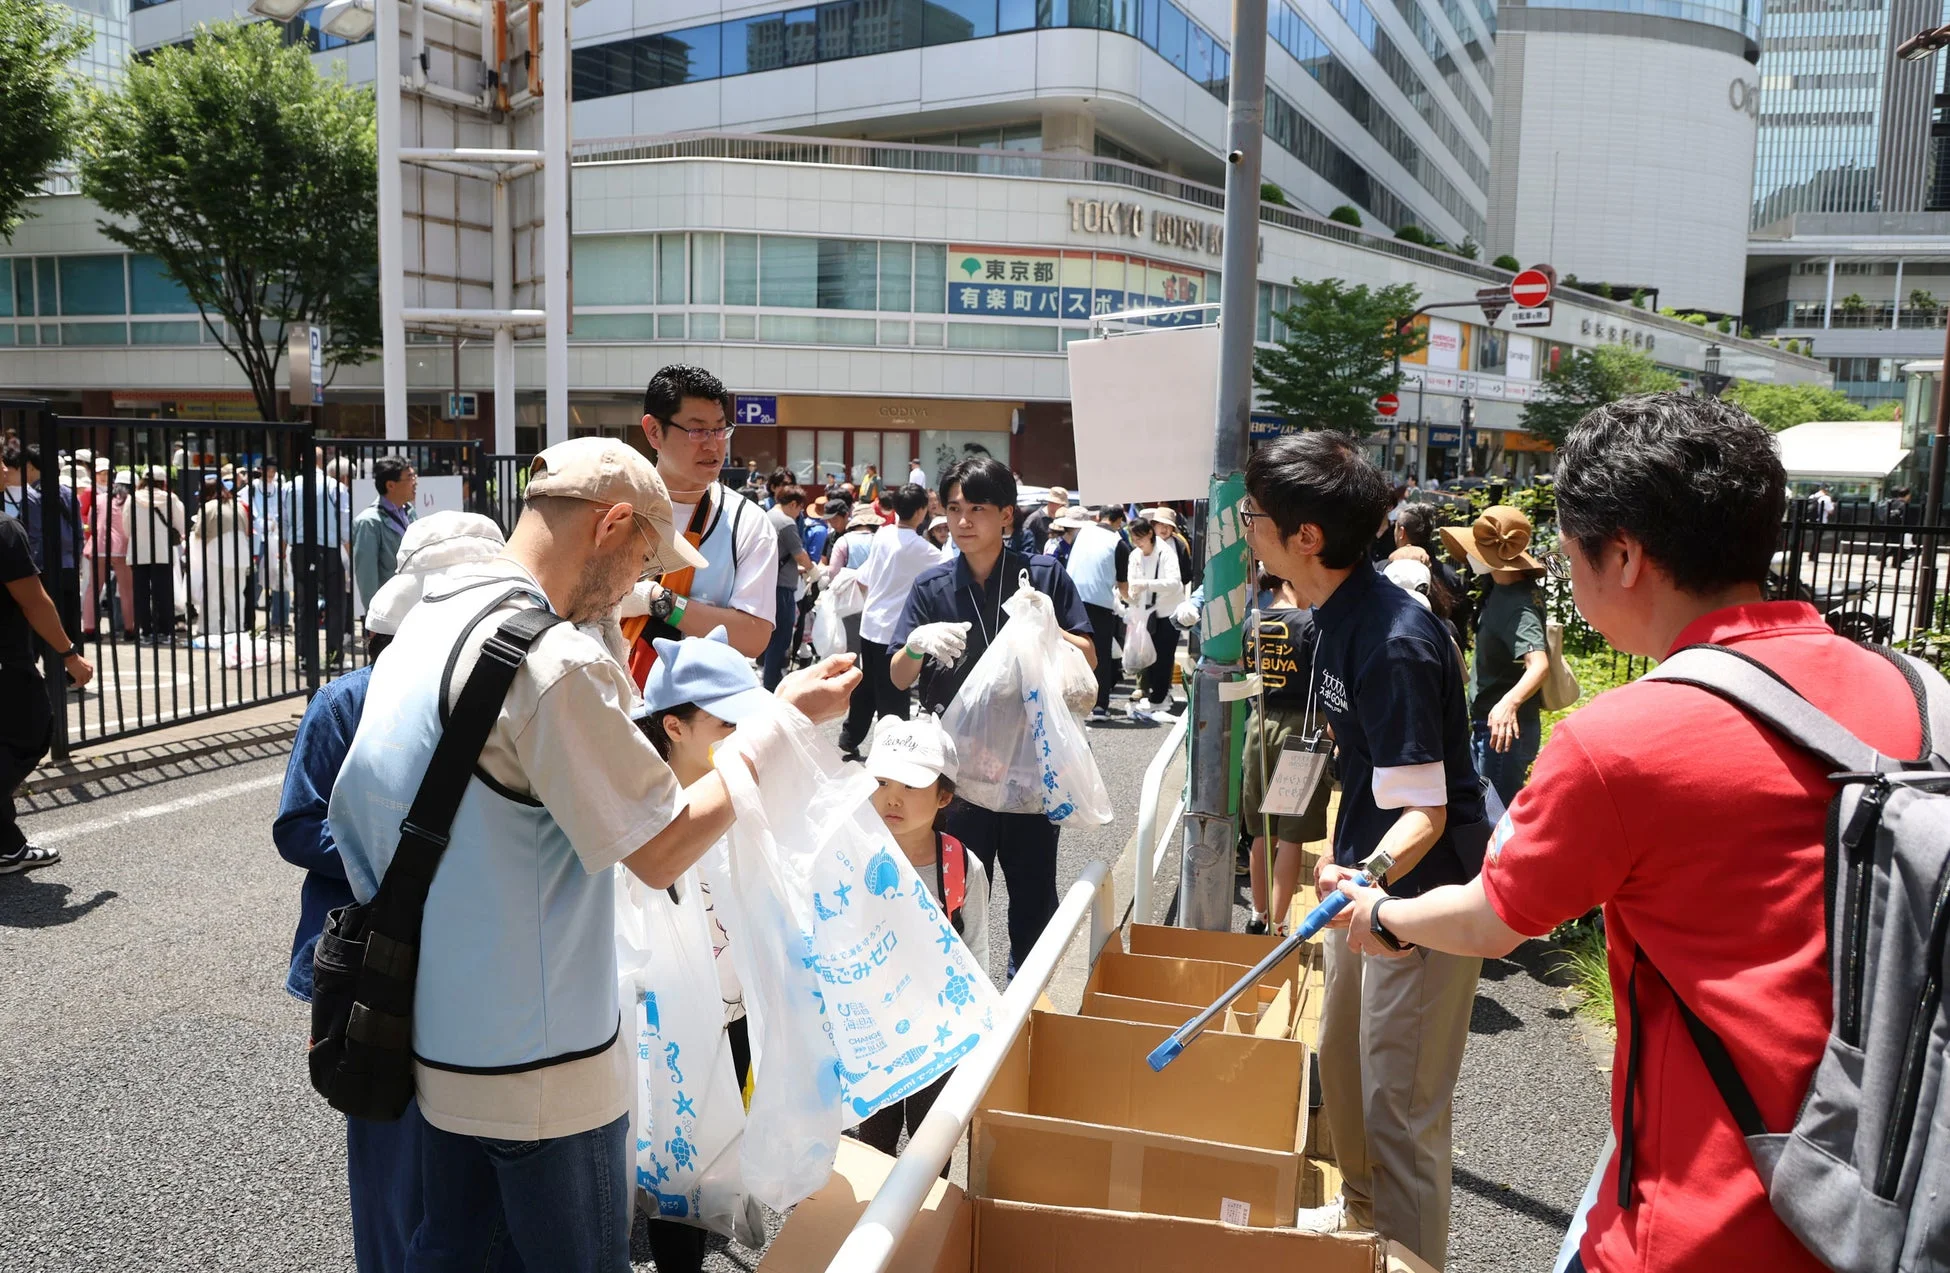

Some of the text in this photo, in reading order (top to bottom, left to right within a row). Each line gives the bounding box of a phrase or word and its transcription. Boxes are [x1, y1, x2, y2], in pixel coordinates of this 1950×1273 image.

[1067, 199, 1144, 238] TOKYO
[1151, 210, 1204, 251] KOTSU
[985, 259, 1054, 282] 東京都
[311, 331, 318, 360] P
[746, 403, 775, 423] P 20m
[878, 407, 928, 417] GODIVA
[1246, 656, 1298, 672] SBUYA
[848, 1031, 882, 1045] CHANGE
